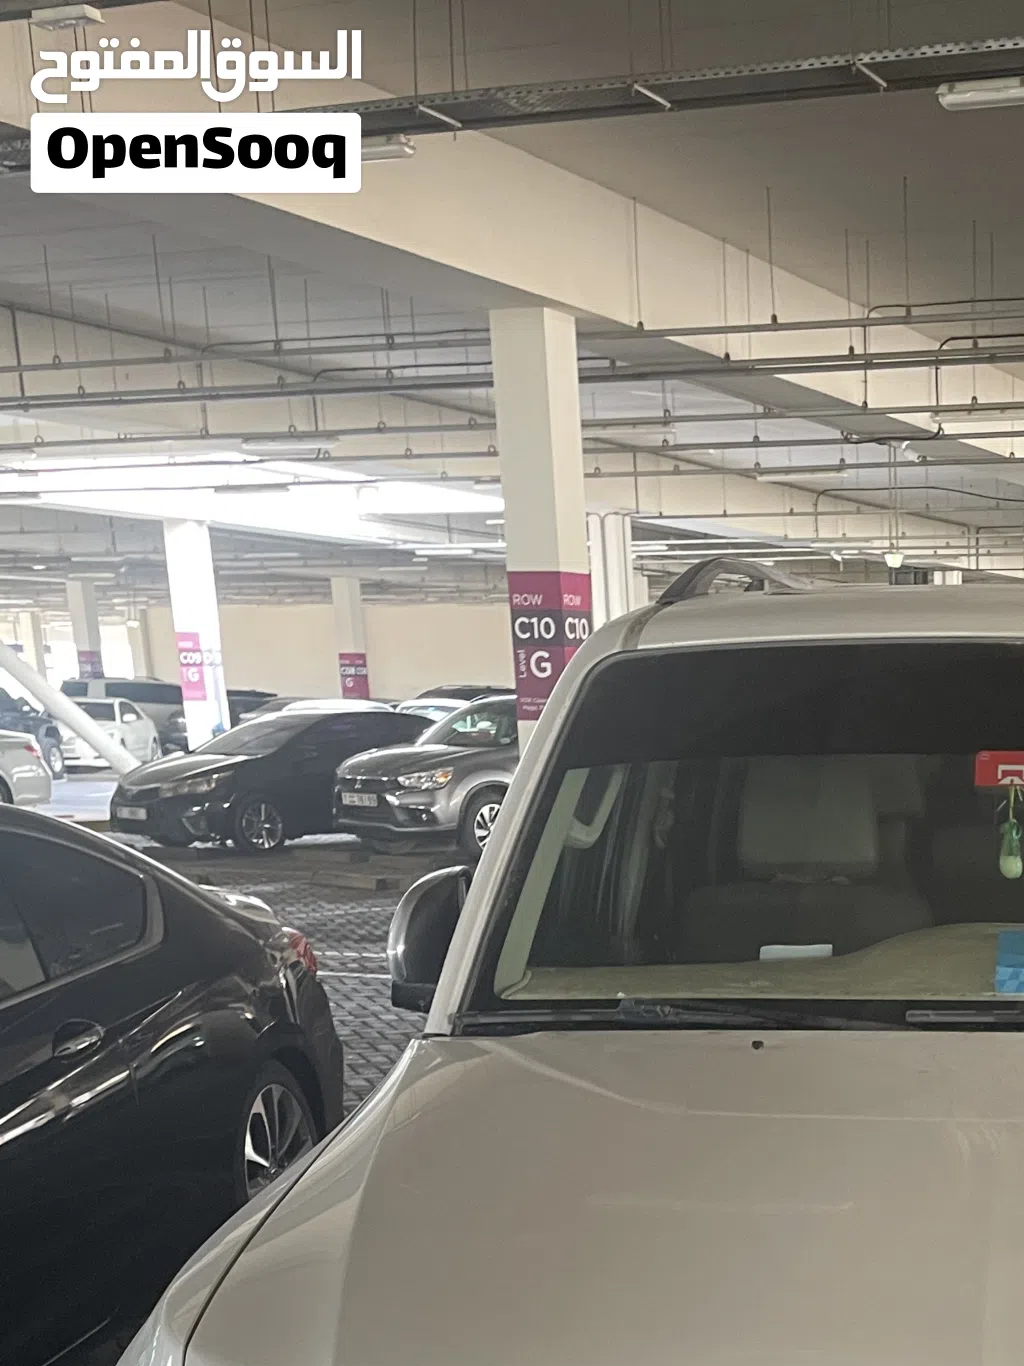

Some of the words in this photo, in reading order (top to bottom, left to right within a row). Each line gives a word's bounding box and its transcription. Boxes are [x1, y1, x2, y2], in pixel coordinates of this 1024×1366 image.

[512, 593, 543, 606] ROW
[563, 593, 582, 606] ROW
[514, 616, 556, 639] C10
[564, 617, 589, 640] C10
[517, 649, 527, 678] Level
[529, 650, 552, 678] G
[187, 667, 200, 683] G
[345, 677, 354, 688] G
